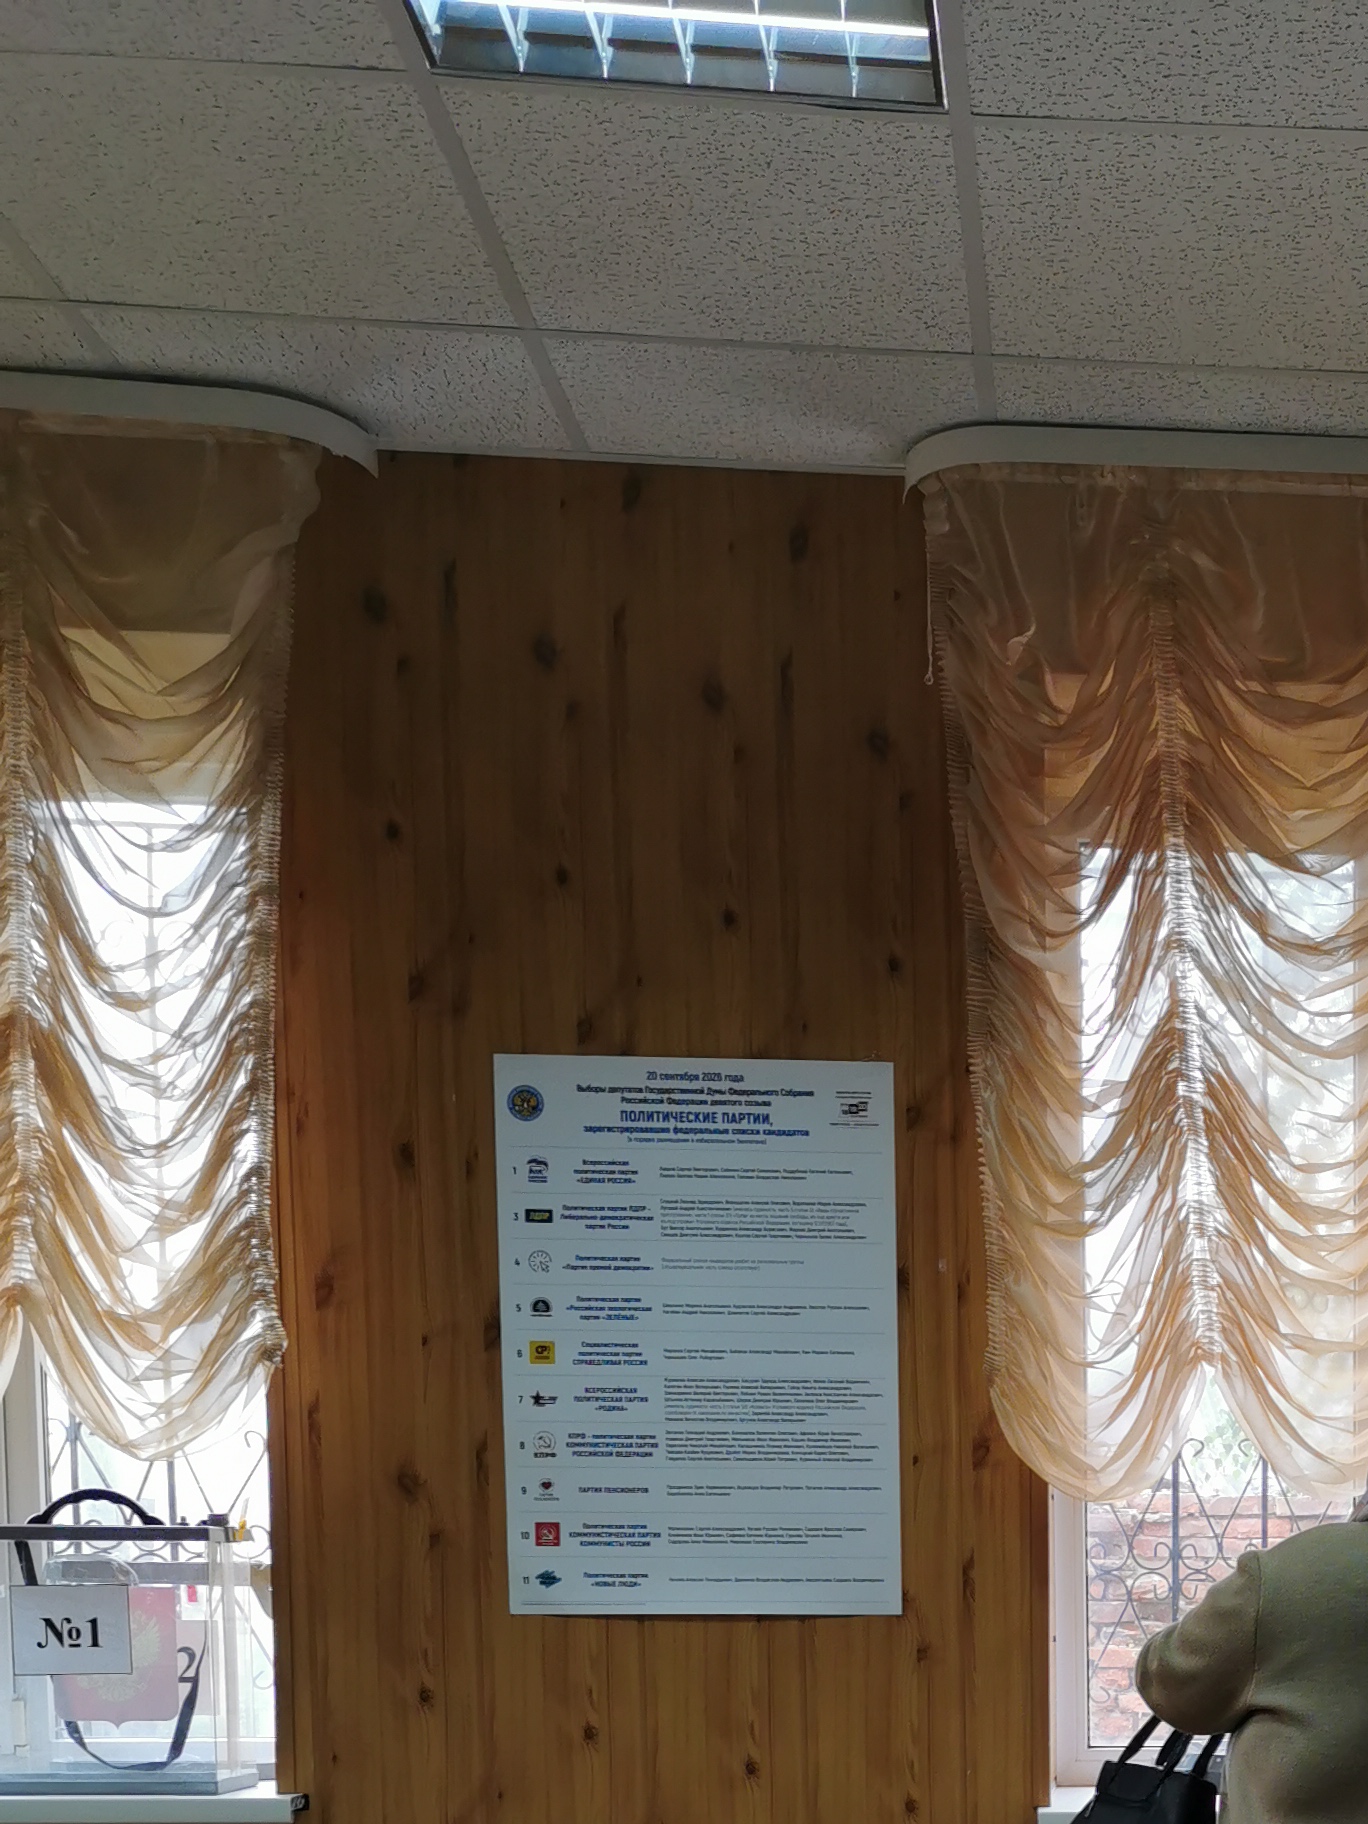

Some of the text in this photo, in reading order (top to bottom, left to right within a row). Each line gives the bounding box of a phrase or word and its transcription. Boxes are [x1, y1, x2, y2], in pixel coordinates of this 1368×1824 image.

[646, 1071, 657, 1080] 20
[659, 1073, 699, 1083] сентября
[724, 1074, 744, 1082] года
[577, 1084, 606, 1093] Выборы
[706, 1086, 726, 1096] Думы
[620, 1110, 773, 1127] ПОЛИТИЧЕСКИЕ ПАРТИИ,
[514, 1213, 518, 1221] 3
[514, 1259, 520, 1267] 4
[516, 1304, 521, 1312] 5
[521, 1531, 530, 1539] 10
[523, 1576, 529, 1584] 11
[36, 1617, 103, 1648] №1
